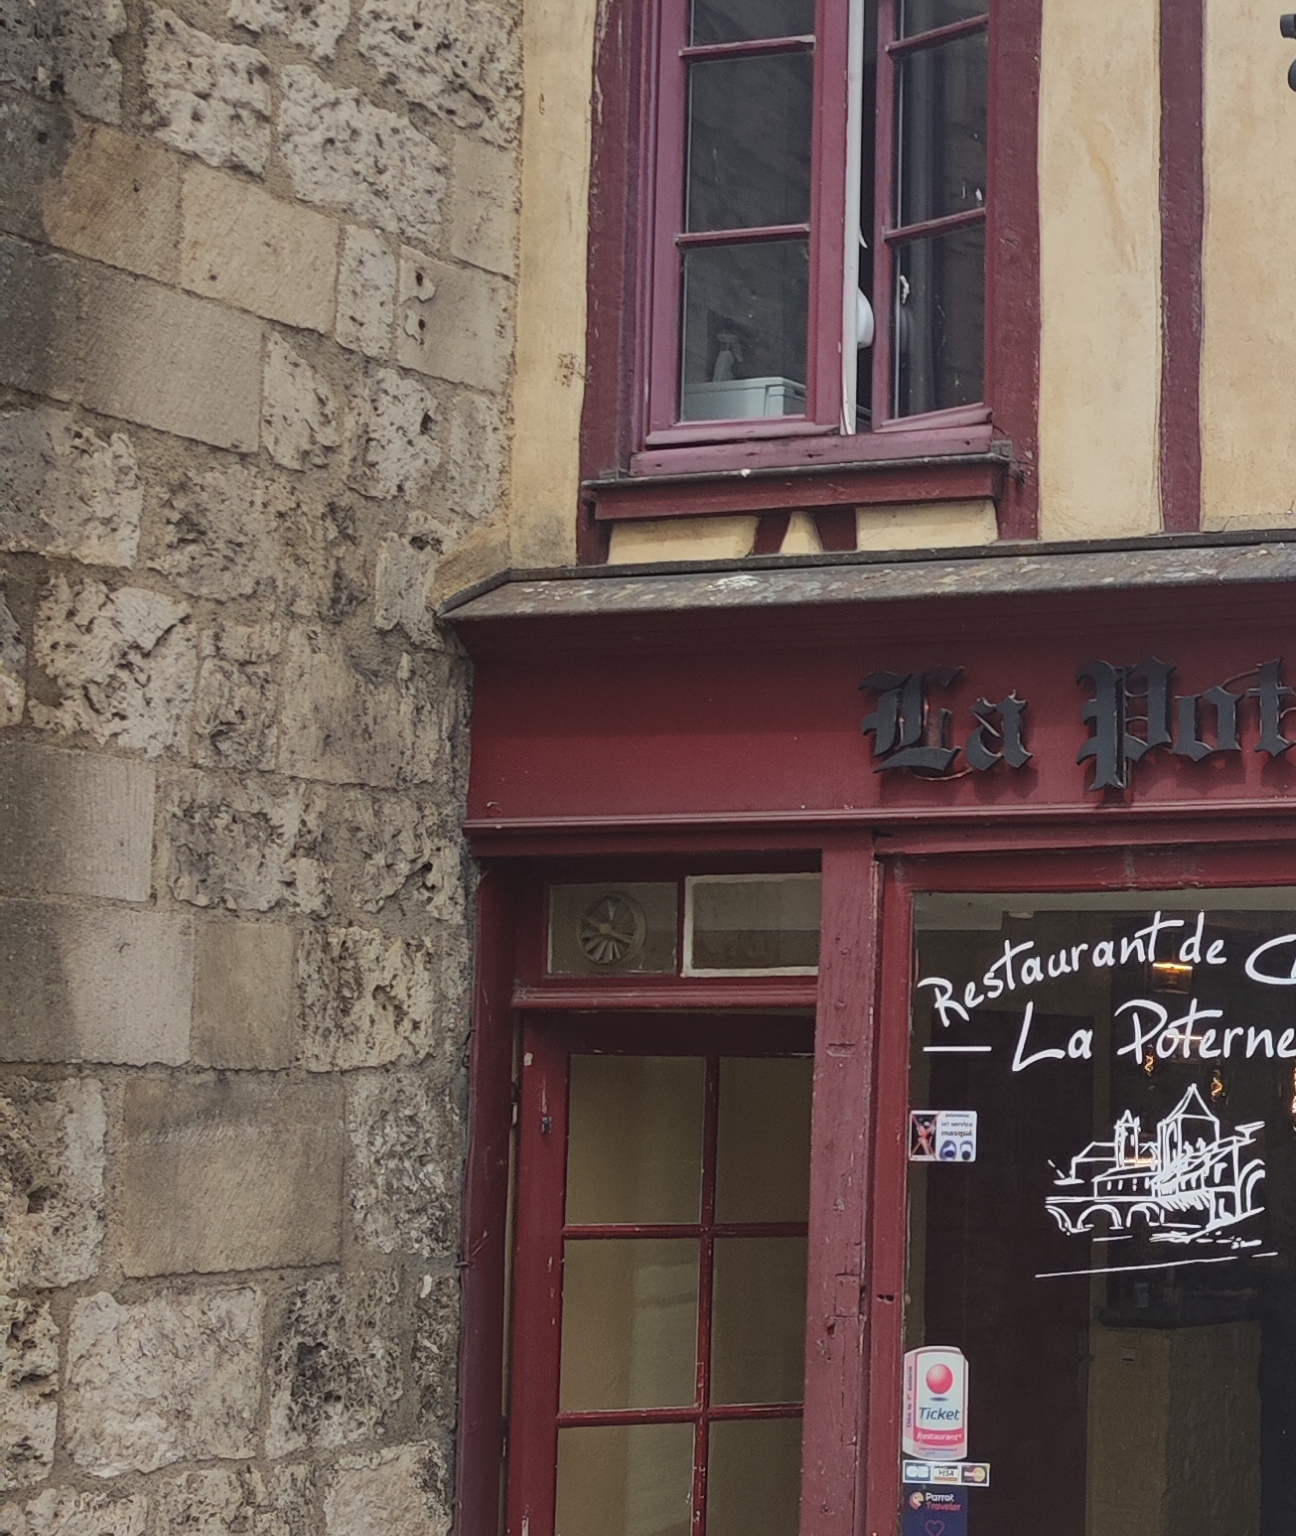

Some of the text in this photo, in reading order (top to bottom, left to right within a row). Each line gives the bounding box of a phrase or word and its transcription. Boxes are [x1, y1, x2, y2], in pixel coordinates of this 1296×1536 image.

[861, 666, 1033, 773] La
[917, 910, 1184, 1027] Restaurant
[1180, 910, 1227, 964] de
[1012, 1001, 1093, 1072] La
[919, 1407, 960, 1421] Ticket
[938, 1469, 954, 1477] VISA
[925, 1492, 955, 1502] Parrot
